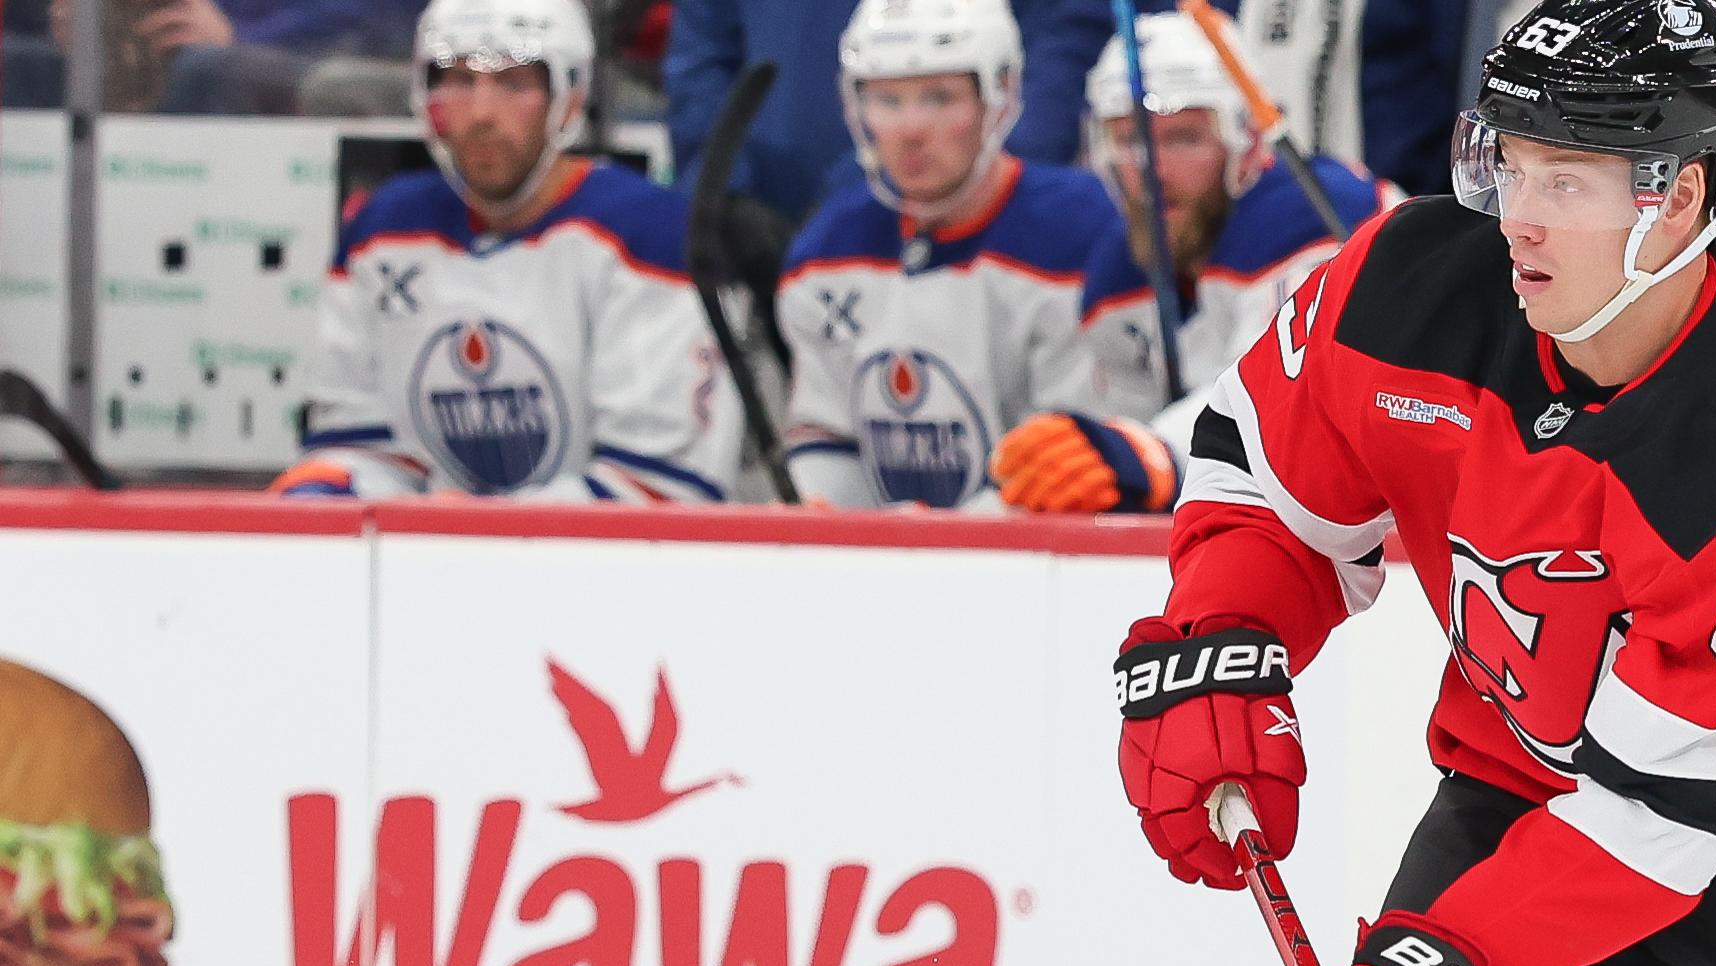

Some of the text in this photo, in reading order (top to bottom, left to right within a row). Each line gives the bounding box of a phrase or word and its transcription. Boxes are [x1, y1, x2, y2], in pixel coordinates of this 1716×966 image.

[1516, 17, 1581, 57] 63
[1669, 34, 1715, 52] Prudential
[1391, 410, 1435, 423] HEALTH
